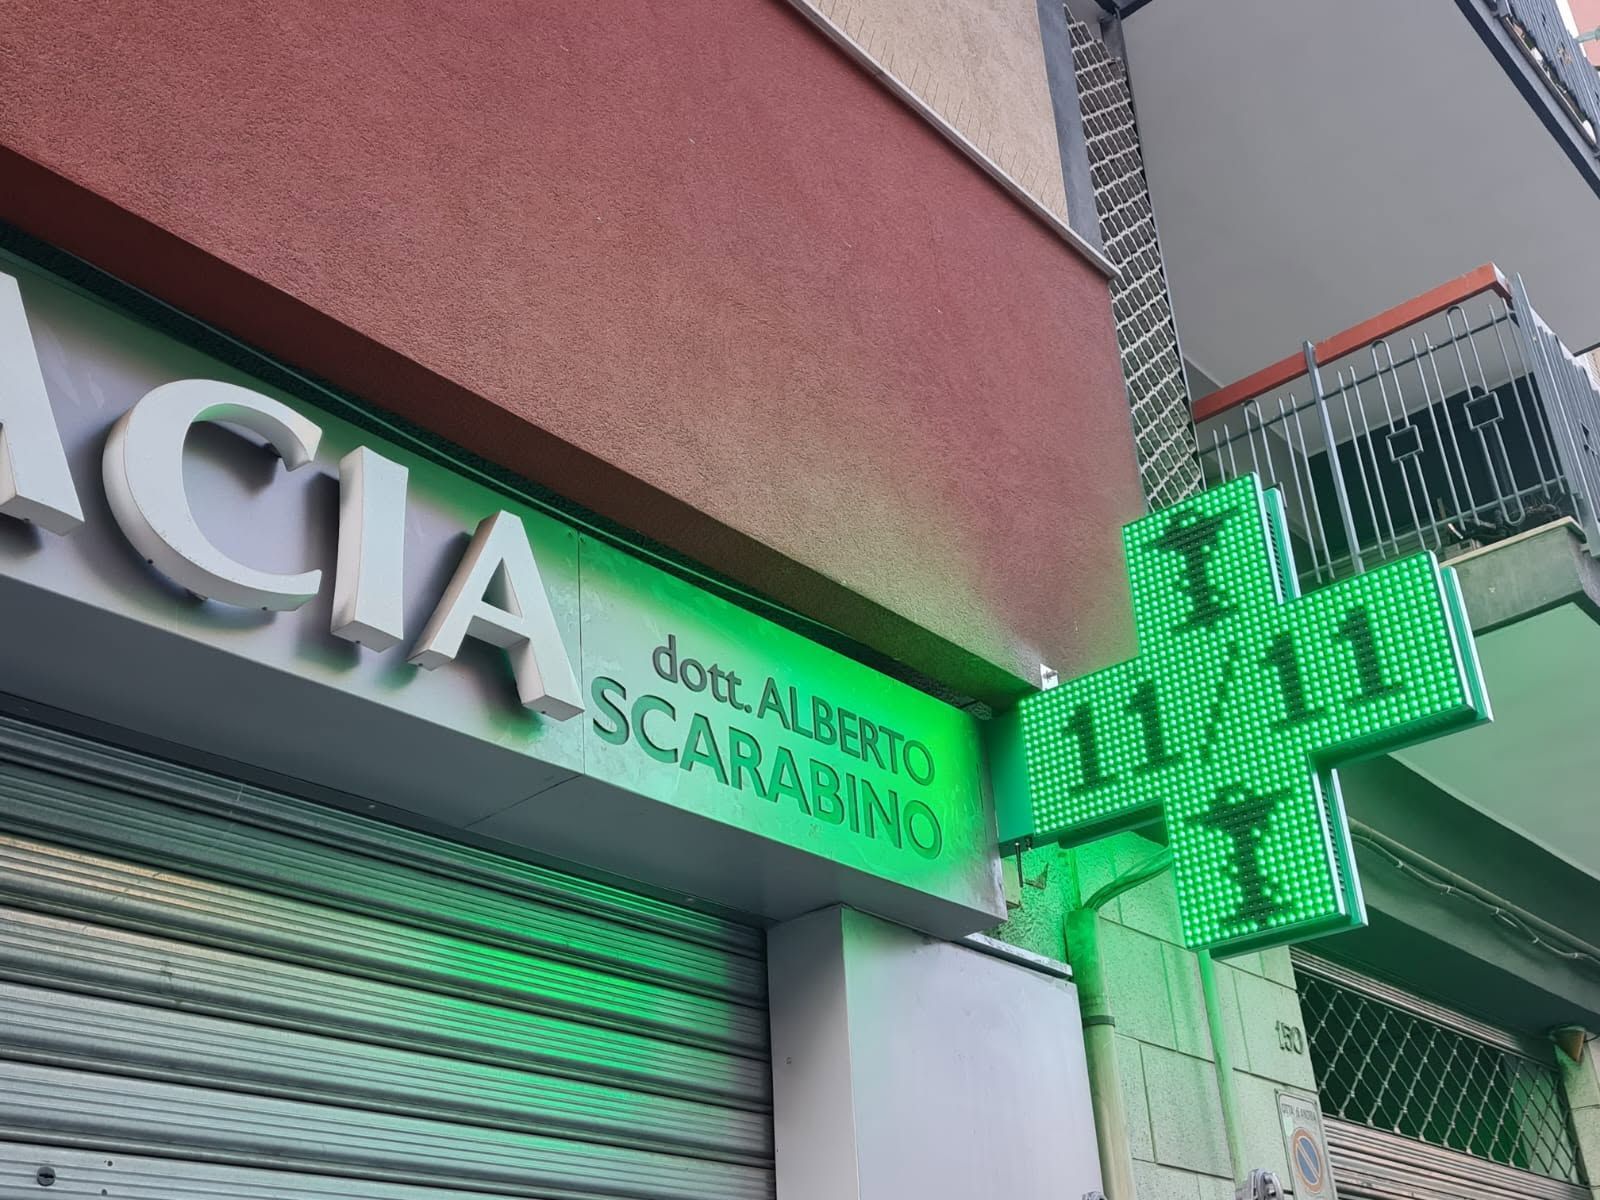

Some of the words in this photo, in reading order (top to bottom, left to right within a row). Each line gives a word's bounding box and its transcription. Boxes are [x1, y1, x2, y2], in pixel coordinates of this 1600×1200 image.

[590, 676, 943, 860] SCARABINO
[652, 633, 752, 714] dott.
[757, 676, 936, 786] ALBERTO
[1275, 1020, 1304, 1055] 150
